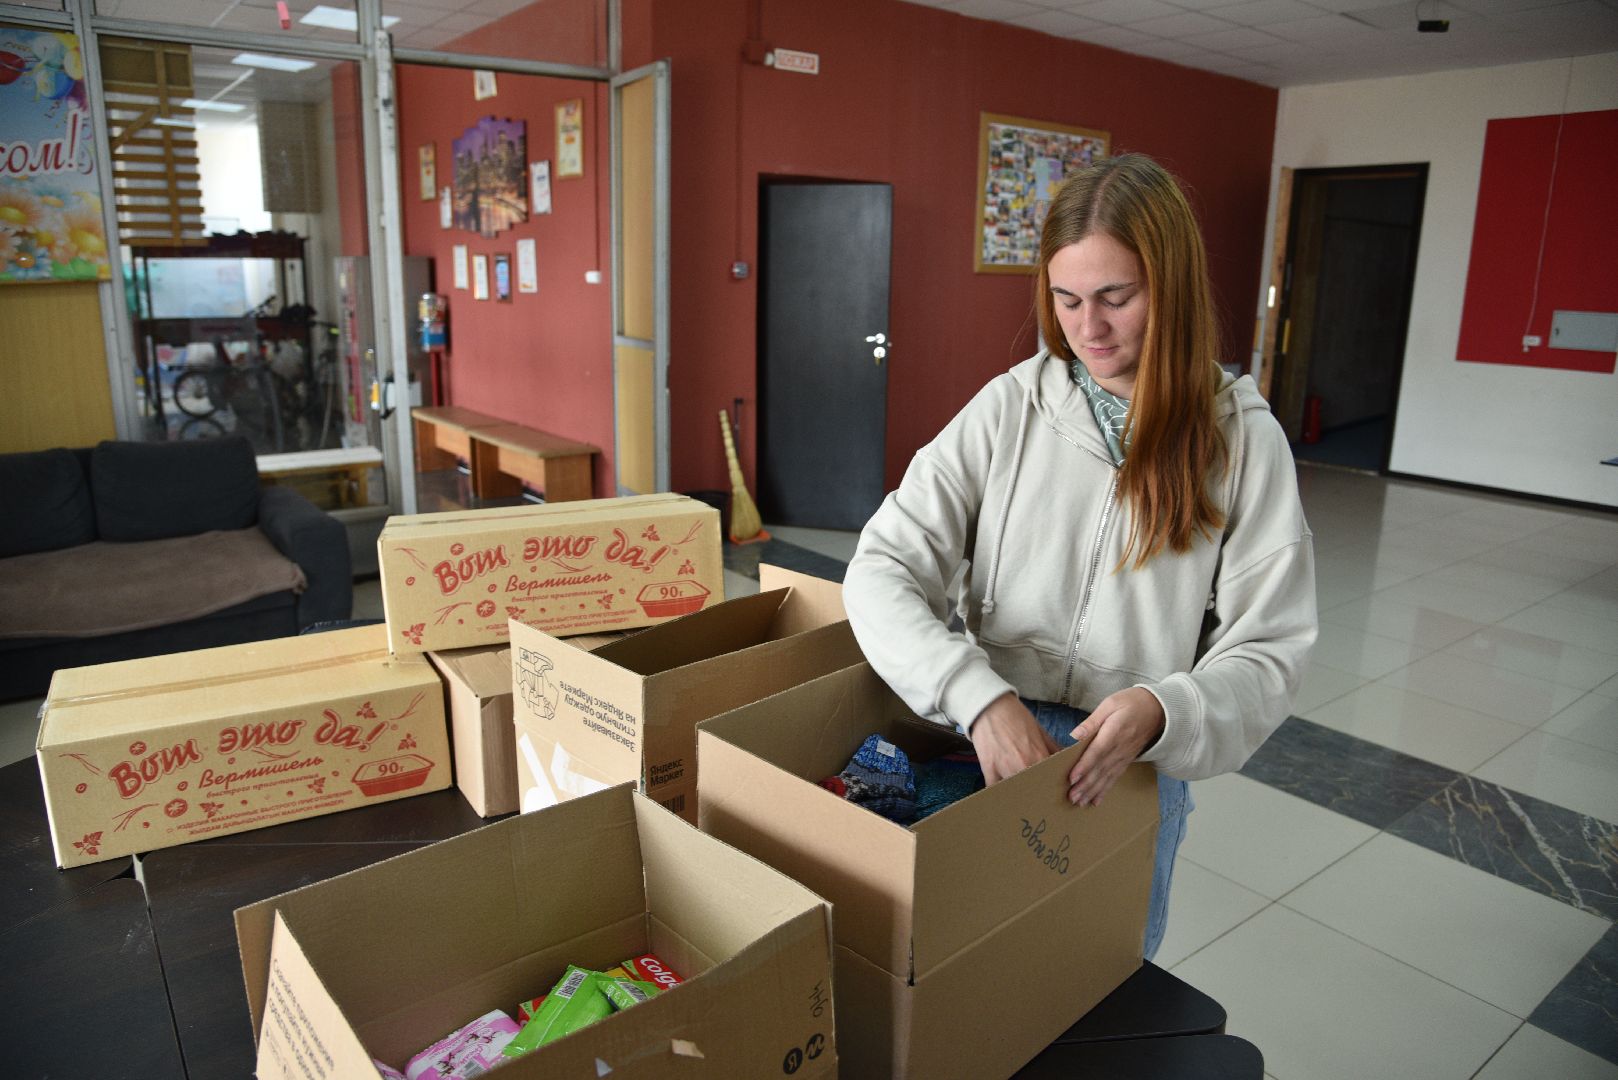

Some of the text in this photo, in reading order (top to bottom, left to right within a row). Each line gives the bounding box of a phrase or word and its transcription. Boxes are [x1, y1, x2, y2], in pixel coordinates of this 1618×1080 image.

[434, 527, 669, 596] Вот это да!
[505, 573, 612, 596] Вермишель
[559, 680, 636, 725] на Яндекс Маркете
[564, 693, 636, 737] стильную одежду
[582, 716, 636, 753] Заказывайте
[108, 709, 389, 799] Вот это да!
[650, 758, 683, 777] Яндекс
[199, 757, 324, 790] Вермишель
[650, 769, 684, 788] Маркет
